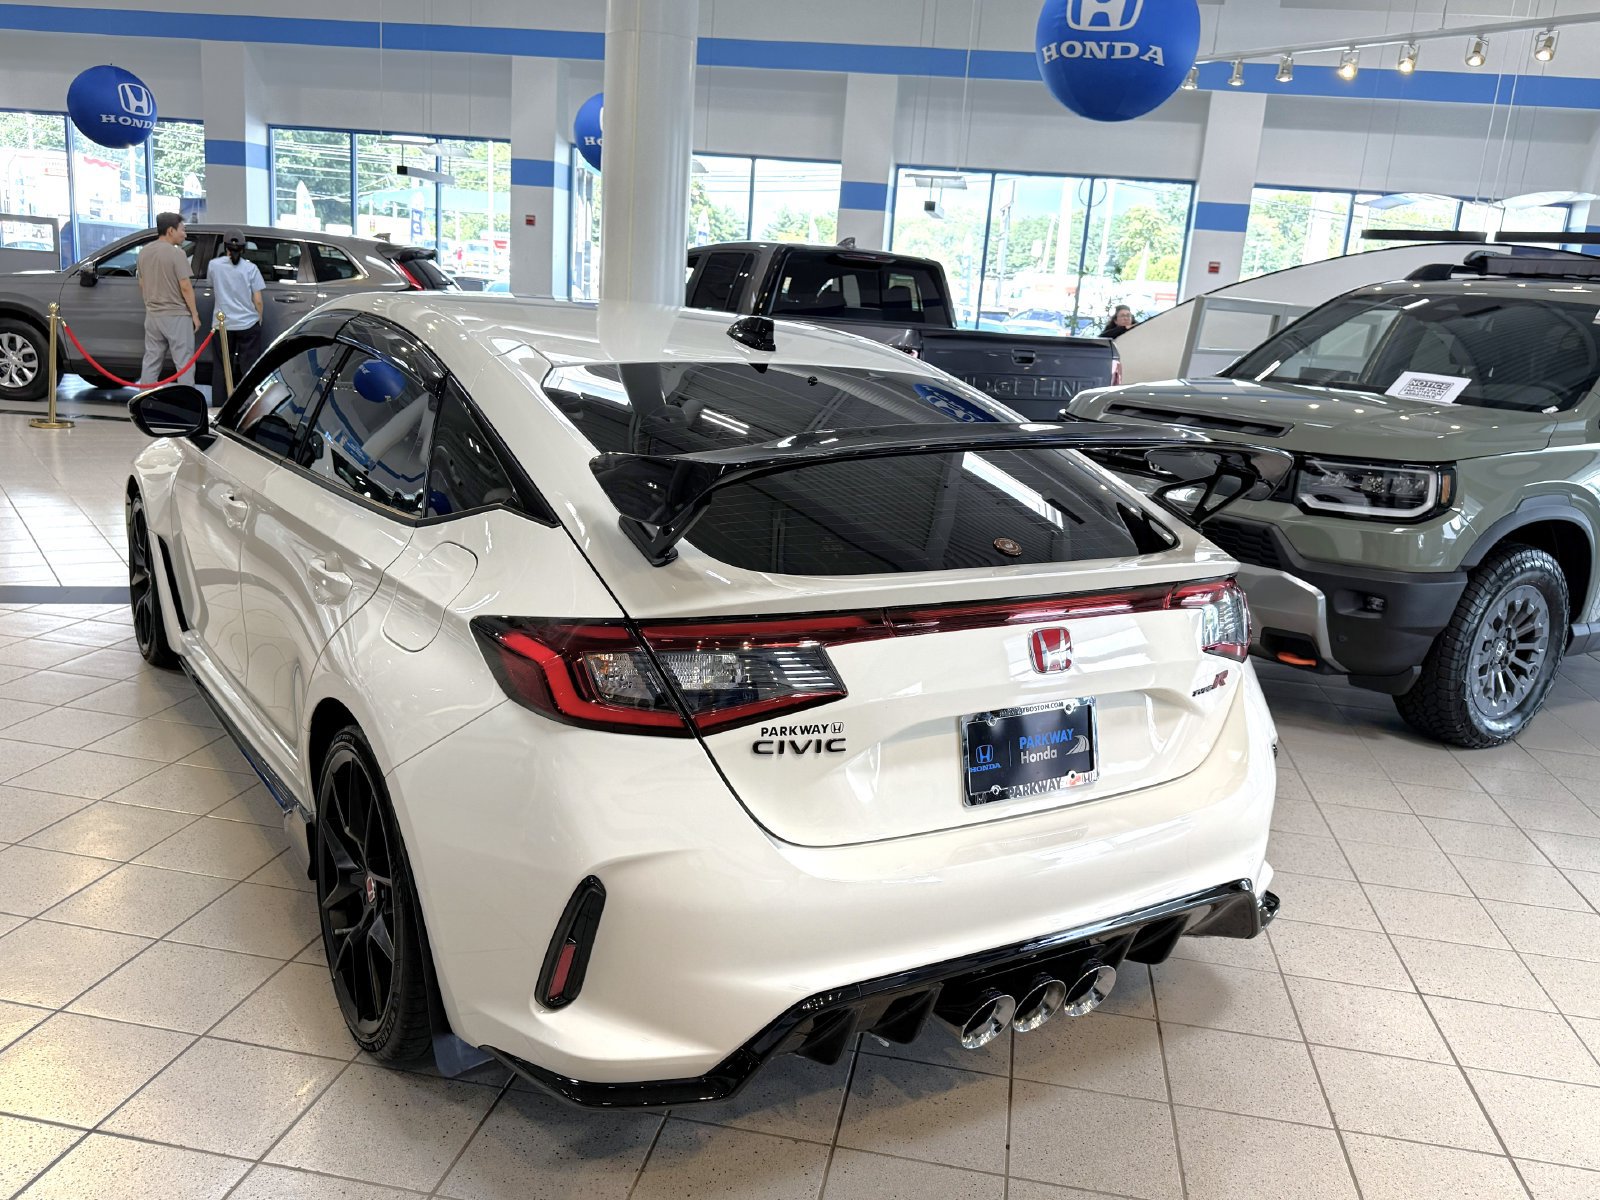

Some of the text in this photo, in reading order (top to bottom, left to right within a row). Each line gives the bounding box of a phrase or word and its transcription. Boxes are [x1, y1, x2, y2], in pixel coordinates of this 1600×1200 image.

[1041, 41, 1165, 67] HONDA
[1409, 380, 1450, 390] NOTICE
[761, 723, 829, 737] PARKWAY
[752, 738, 846, 755] CIVIC
[1019, 728, 1074, 750] PARKWAY
[1020, 746, 1057, 764] Honda
[969, 762, 1001, 773] HONDA
[1007, 777, 1062, 799] PARKWAY
